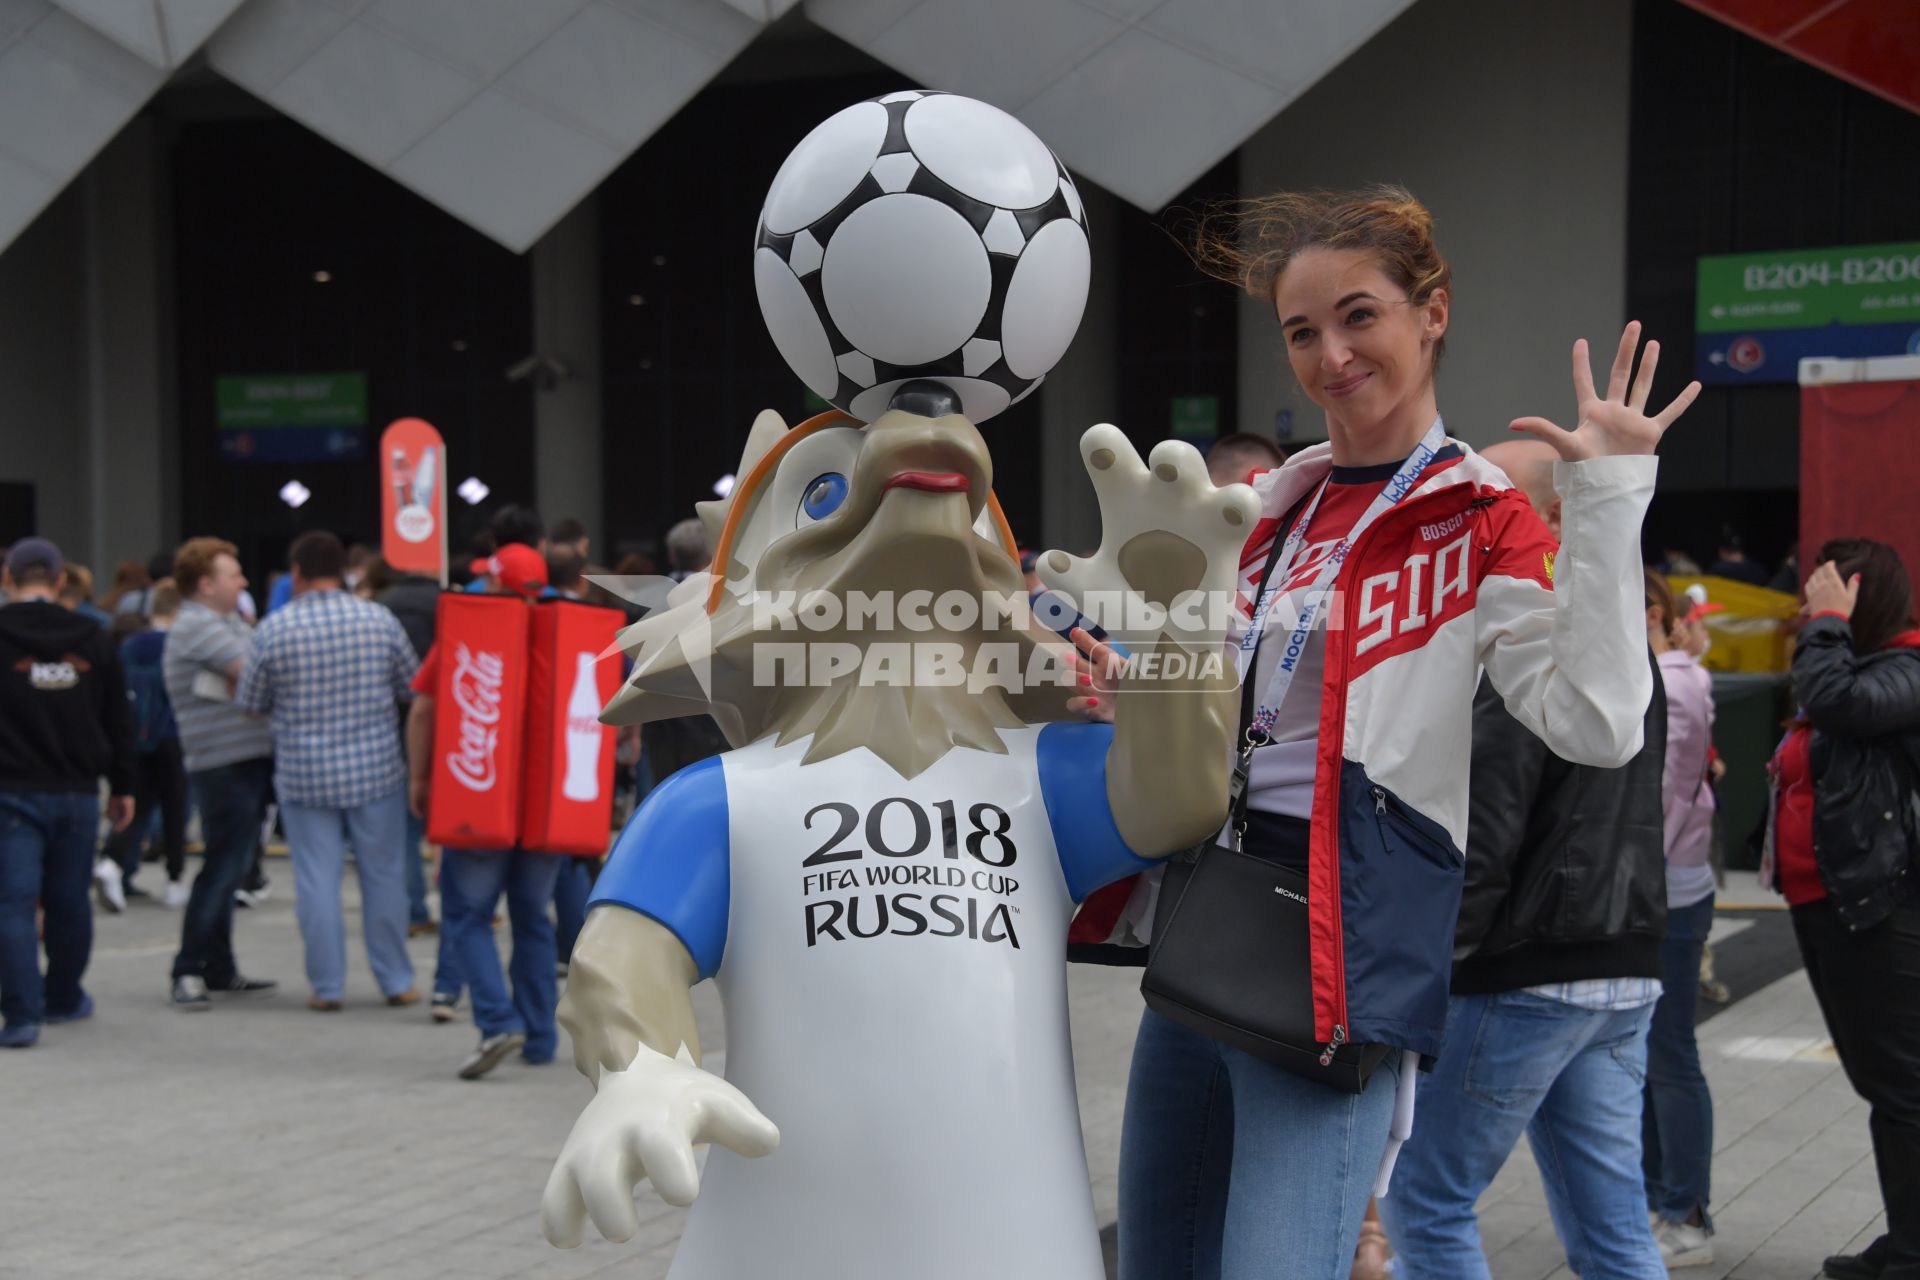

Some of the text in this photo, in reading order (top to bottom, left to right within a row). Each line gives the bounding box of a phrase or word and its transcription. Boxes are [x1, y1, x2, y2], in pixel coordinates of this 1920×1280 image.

[1420, 513, 1463, 542] BOSCO
[1356, 528, 1472, 657] SIA
[1280, 604, 1317, 673] МОСКВА
[802, 797, 1017, 868] 2018
[803, 865, 1019, 896] FIFA WORLD CUP
[1274, 885, 1308, 904] MICHAEL
